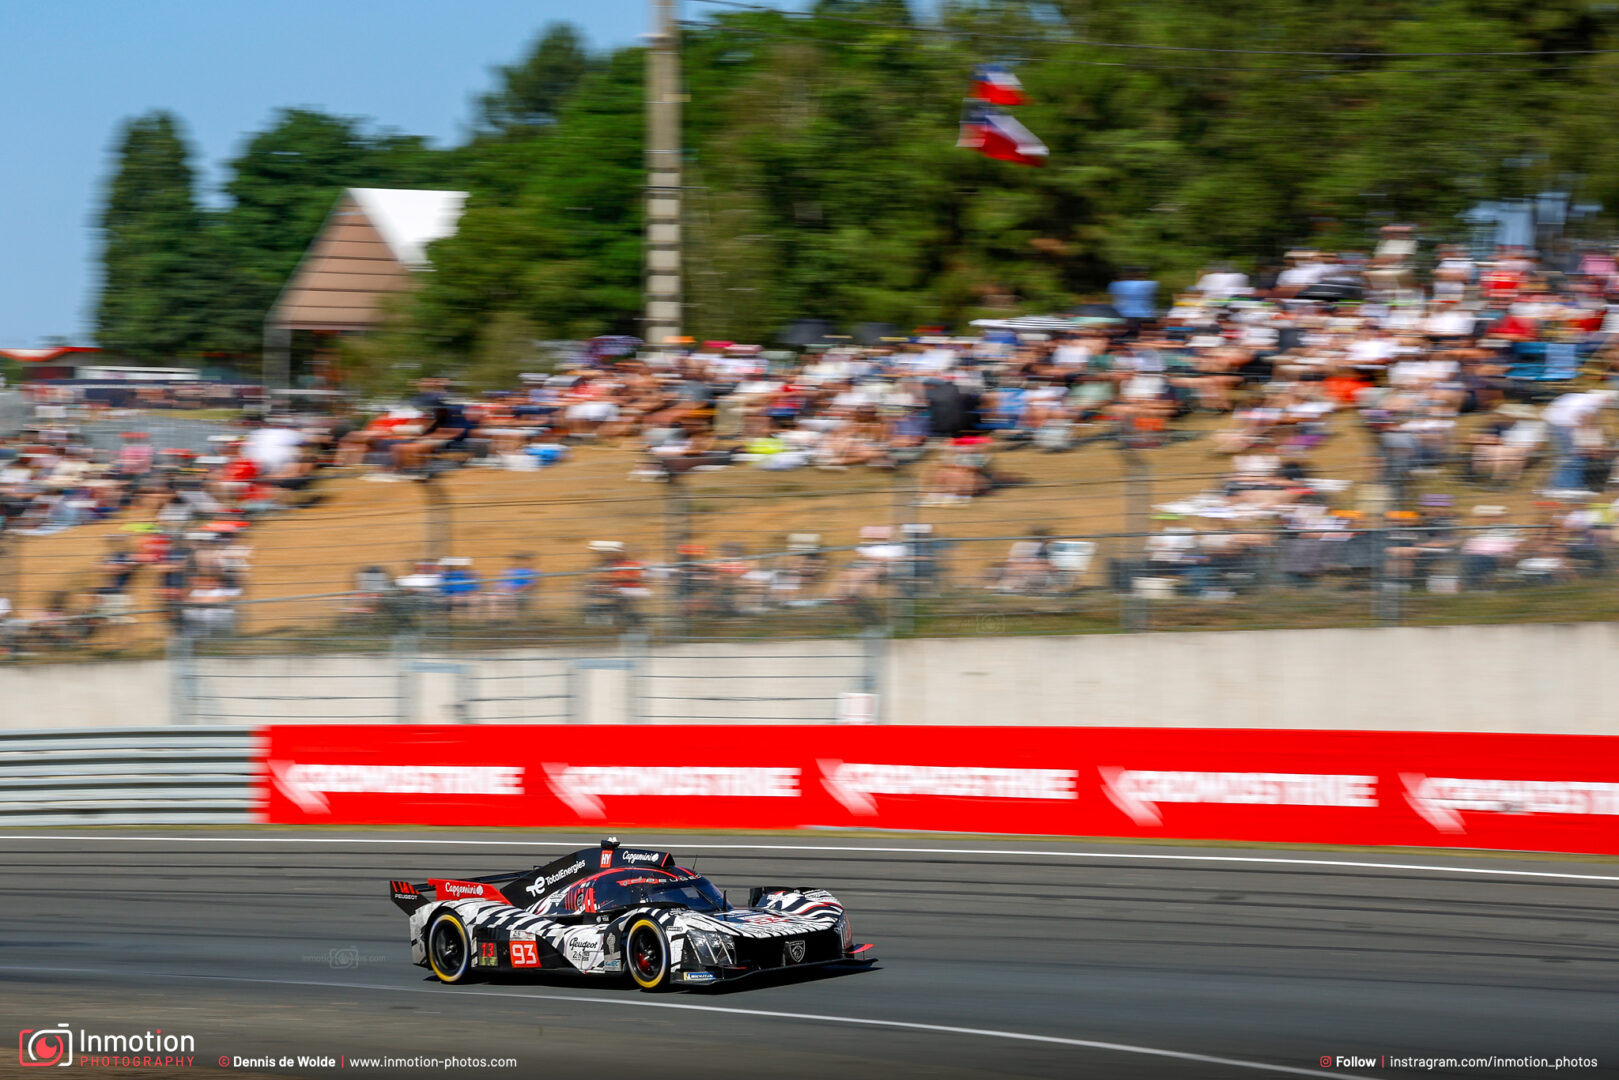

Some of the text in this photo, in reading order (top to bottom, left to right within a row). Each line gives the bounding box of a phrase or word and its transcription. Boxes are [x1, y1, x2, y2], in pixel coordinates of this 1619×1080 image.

[600, 853, 612, 865] HY
[622, 850, 652, 863] Capgemini
[545, 859, 586, 886] TotalEnergies
[445, 882, 477, 897] Capgemini
[569, 937, 598, 951] Peugeot
[512, 944, 537, 964] 93
